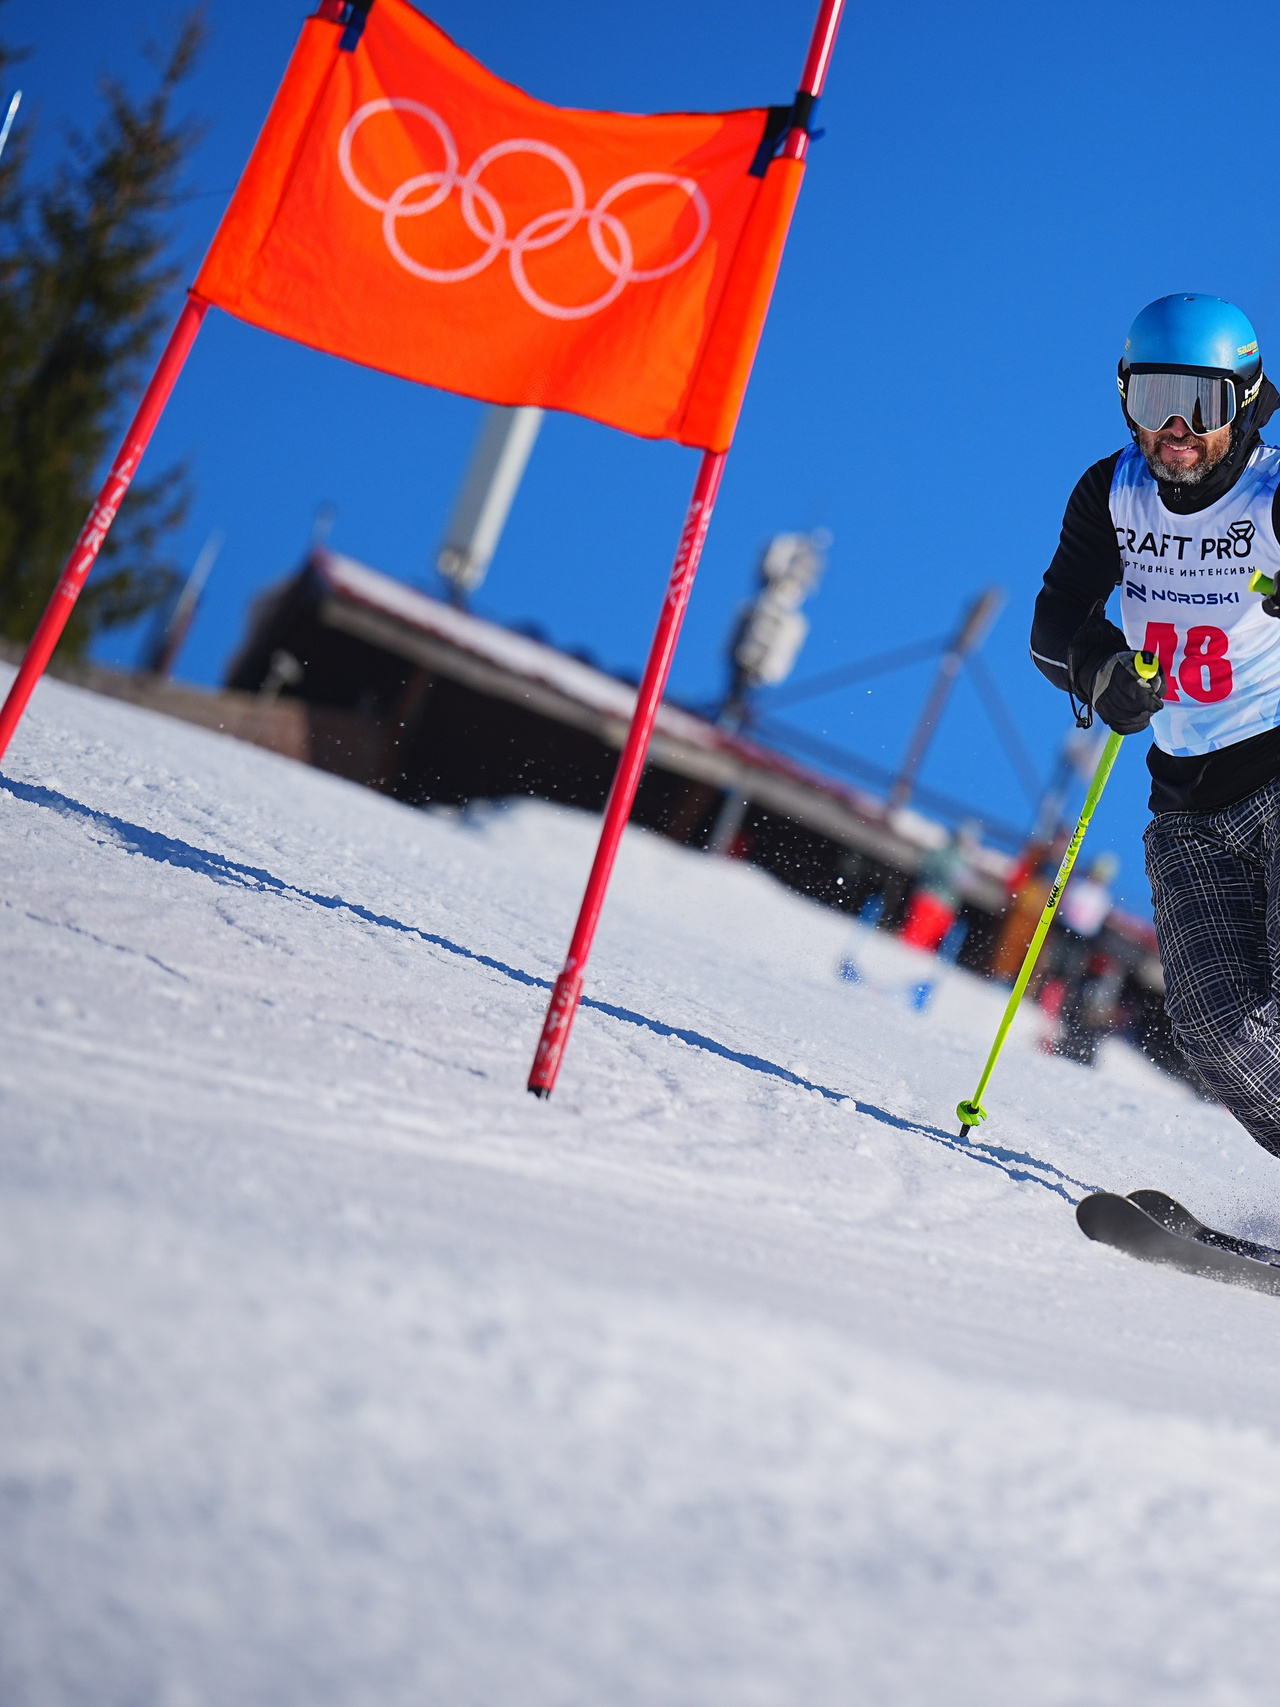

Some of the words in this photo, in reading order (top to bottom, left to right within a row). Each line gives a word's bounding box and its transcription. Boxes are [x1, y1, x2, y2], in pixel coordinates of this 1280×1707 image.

[1115, 527, 1193, 560] CRAFT
[1200, 534, 1252, 561] PRO
[1180, 565, 1256, 577] ИНТЕНСИВЫ
[1151, 589, 1240, 605] NORDSKI
[1143, 621, 1234, 704] 48
